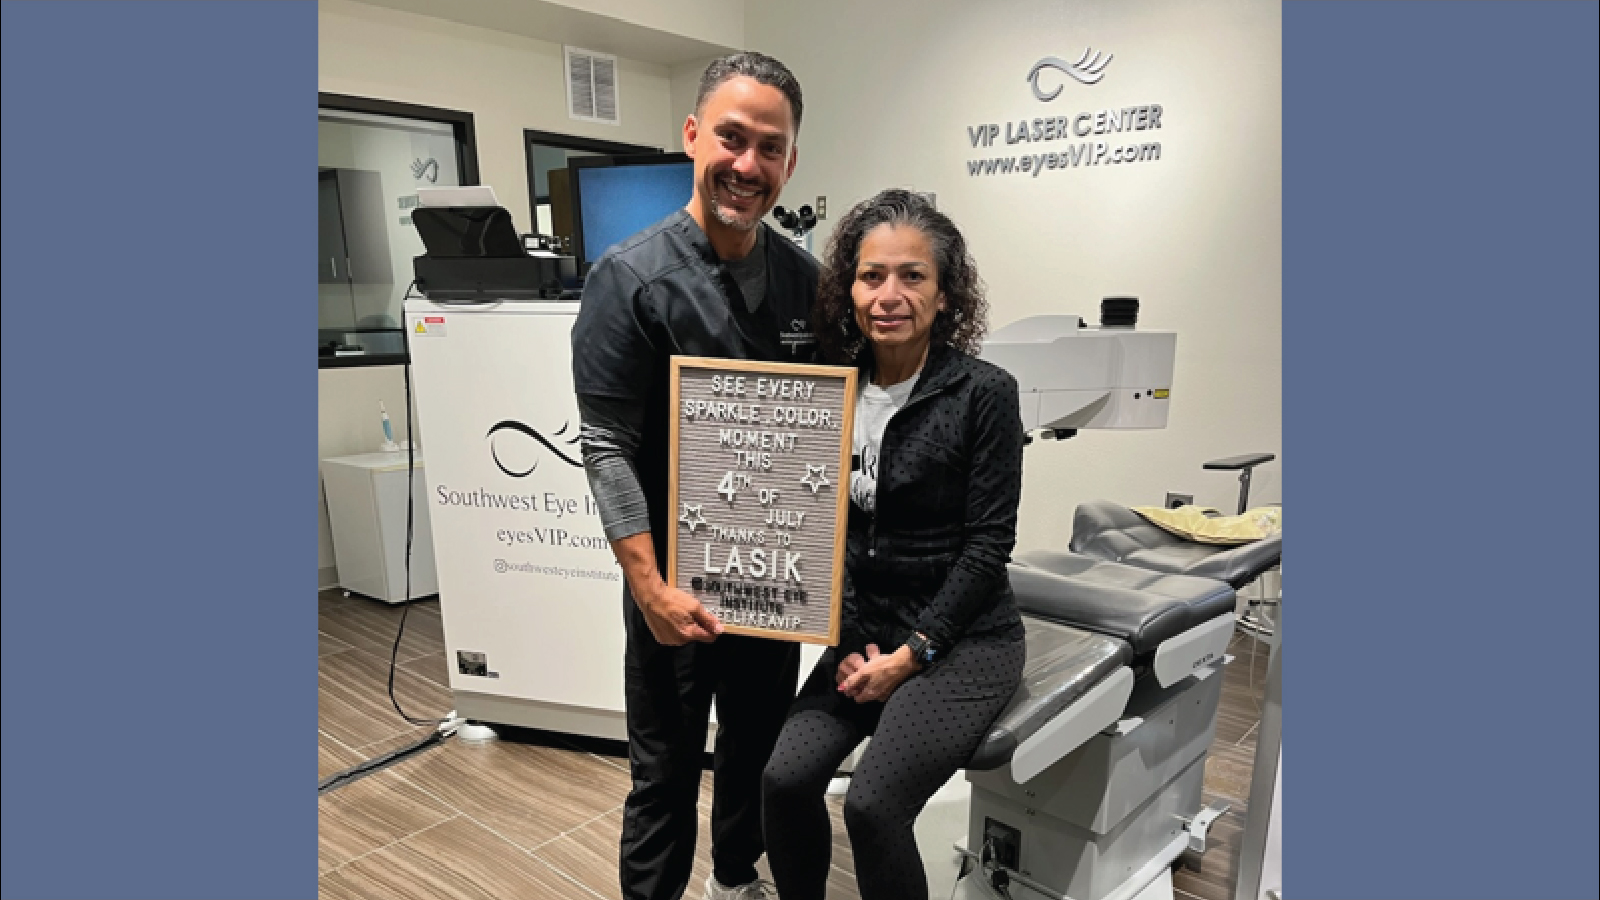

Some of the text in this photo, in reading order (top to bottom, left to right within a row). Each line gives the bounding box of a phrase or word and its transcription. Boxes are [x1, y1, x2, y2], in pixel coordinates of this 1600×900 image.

[967, 104, 1164, 148] VIP LASER CENTER
[967, 142, 1161, 177] www.eyesVIP.com
[711, 375, 815, 398] SEE EVERY
[719, 429, 799, 449] MOMENT
[734, 451, 772, 468] THIS
[436, 485, 538, 511] Southwest
[543, 492, 578, 519] Eye
[759, 488, 780, 504] OF
[765, 508, 805, 526] JULY
[496, 527, 608, 550] eyesVIP.com
[711, 525, 791, 545] THANKS TO
[703, 542, 801, 582] LASIK
